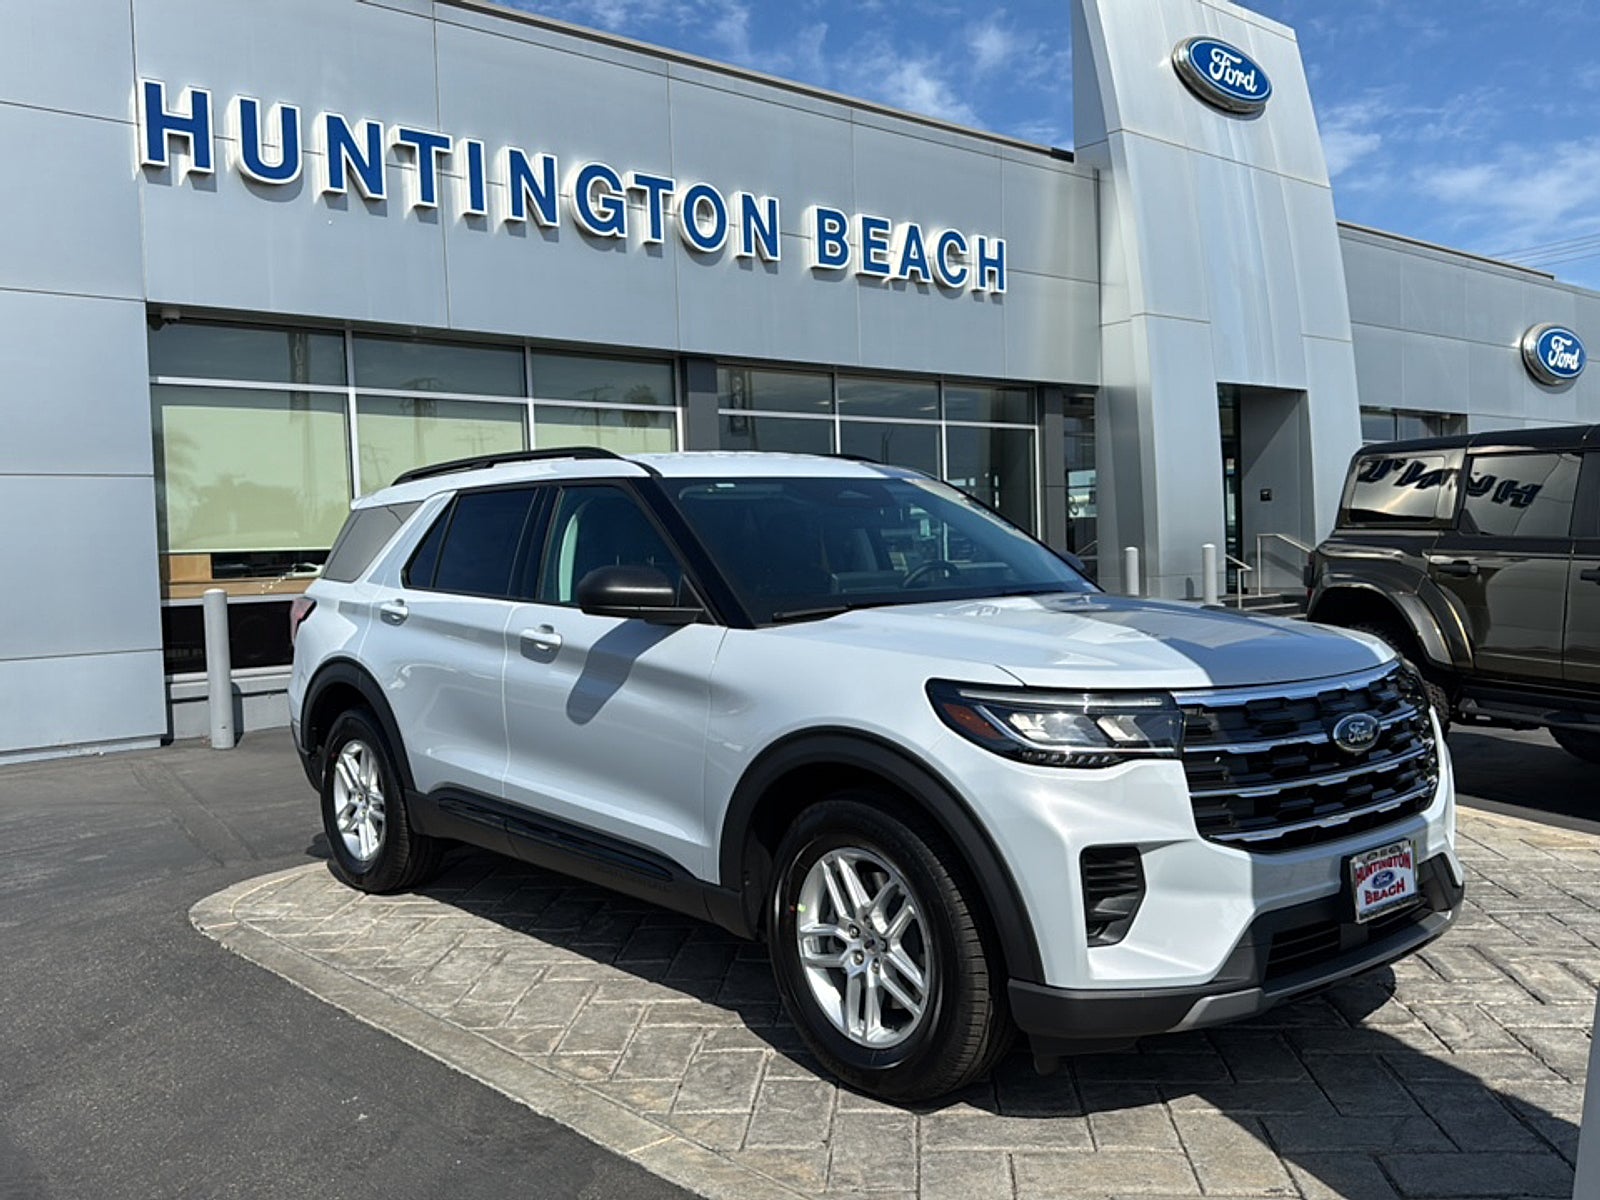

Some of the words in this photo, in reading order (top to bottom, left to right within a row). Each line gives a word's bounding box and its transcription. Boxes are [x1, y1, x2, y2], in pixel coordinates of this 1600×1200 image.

[1208, 47, 1258, 93] Ford
[139, 78, 781, 262] HUNTINGTON
[810, 204, 1008, 294] BEACH
[1547, 335, 1581, 371] Ford
[1347, 720, 1375, 743] Ford
[1356, 852, 1411, 887] HUNTINGTON
[1364, 877, 1405, 905] BEACH
